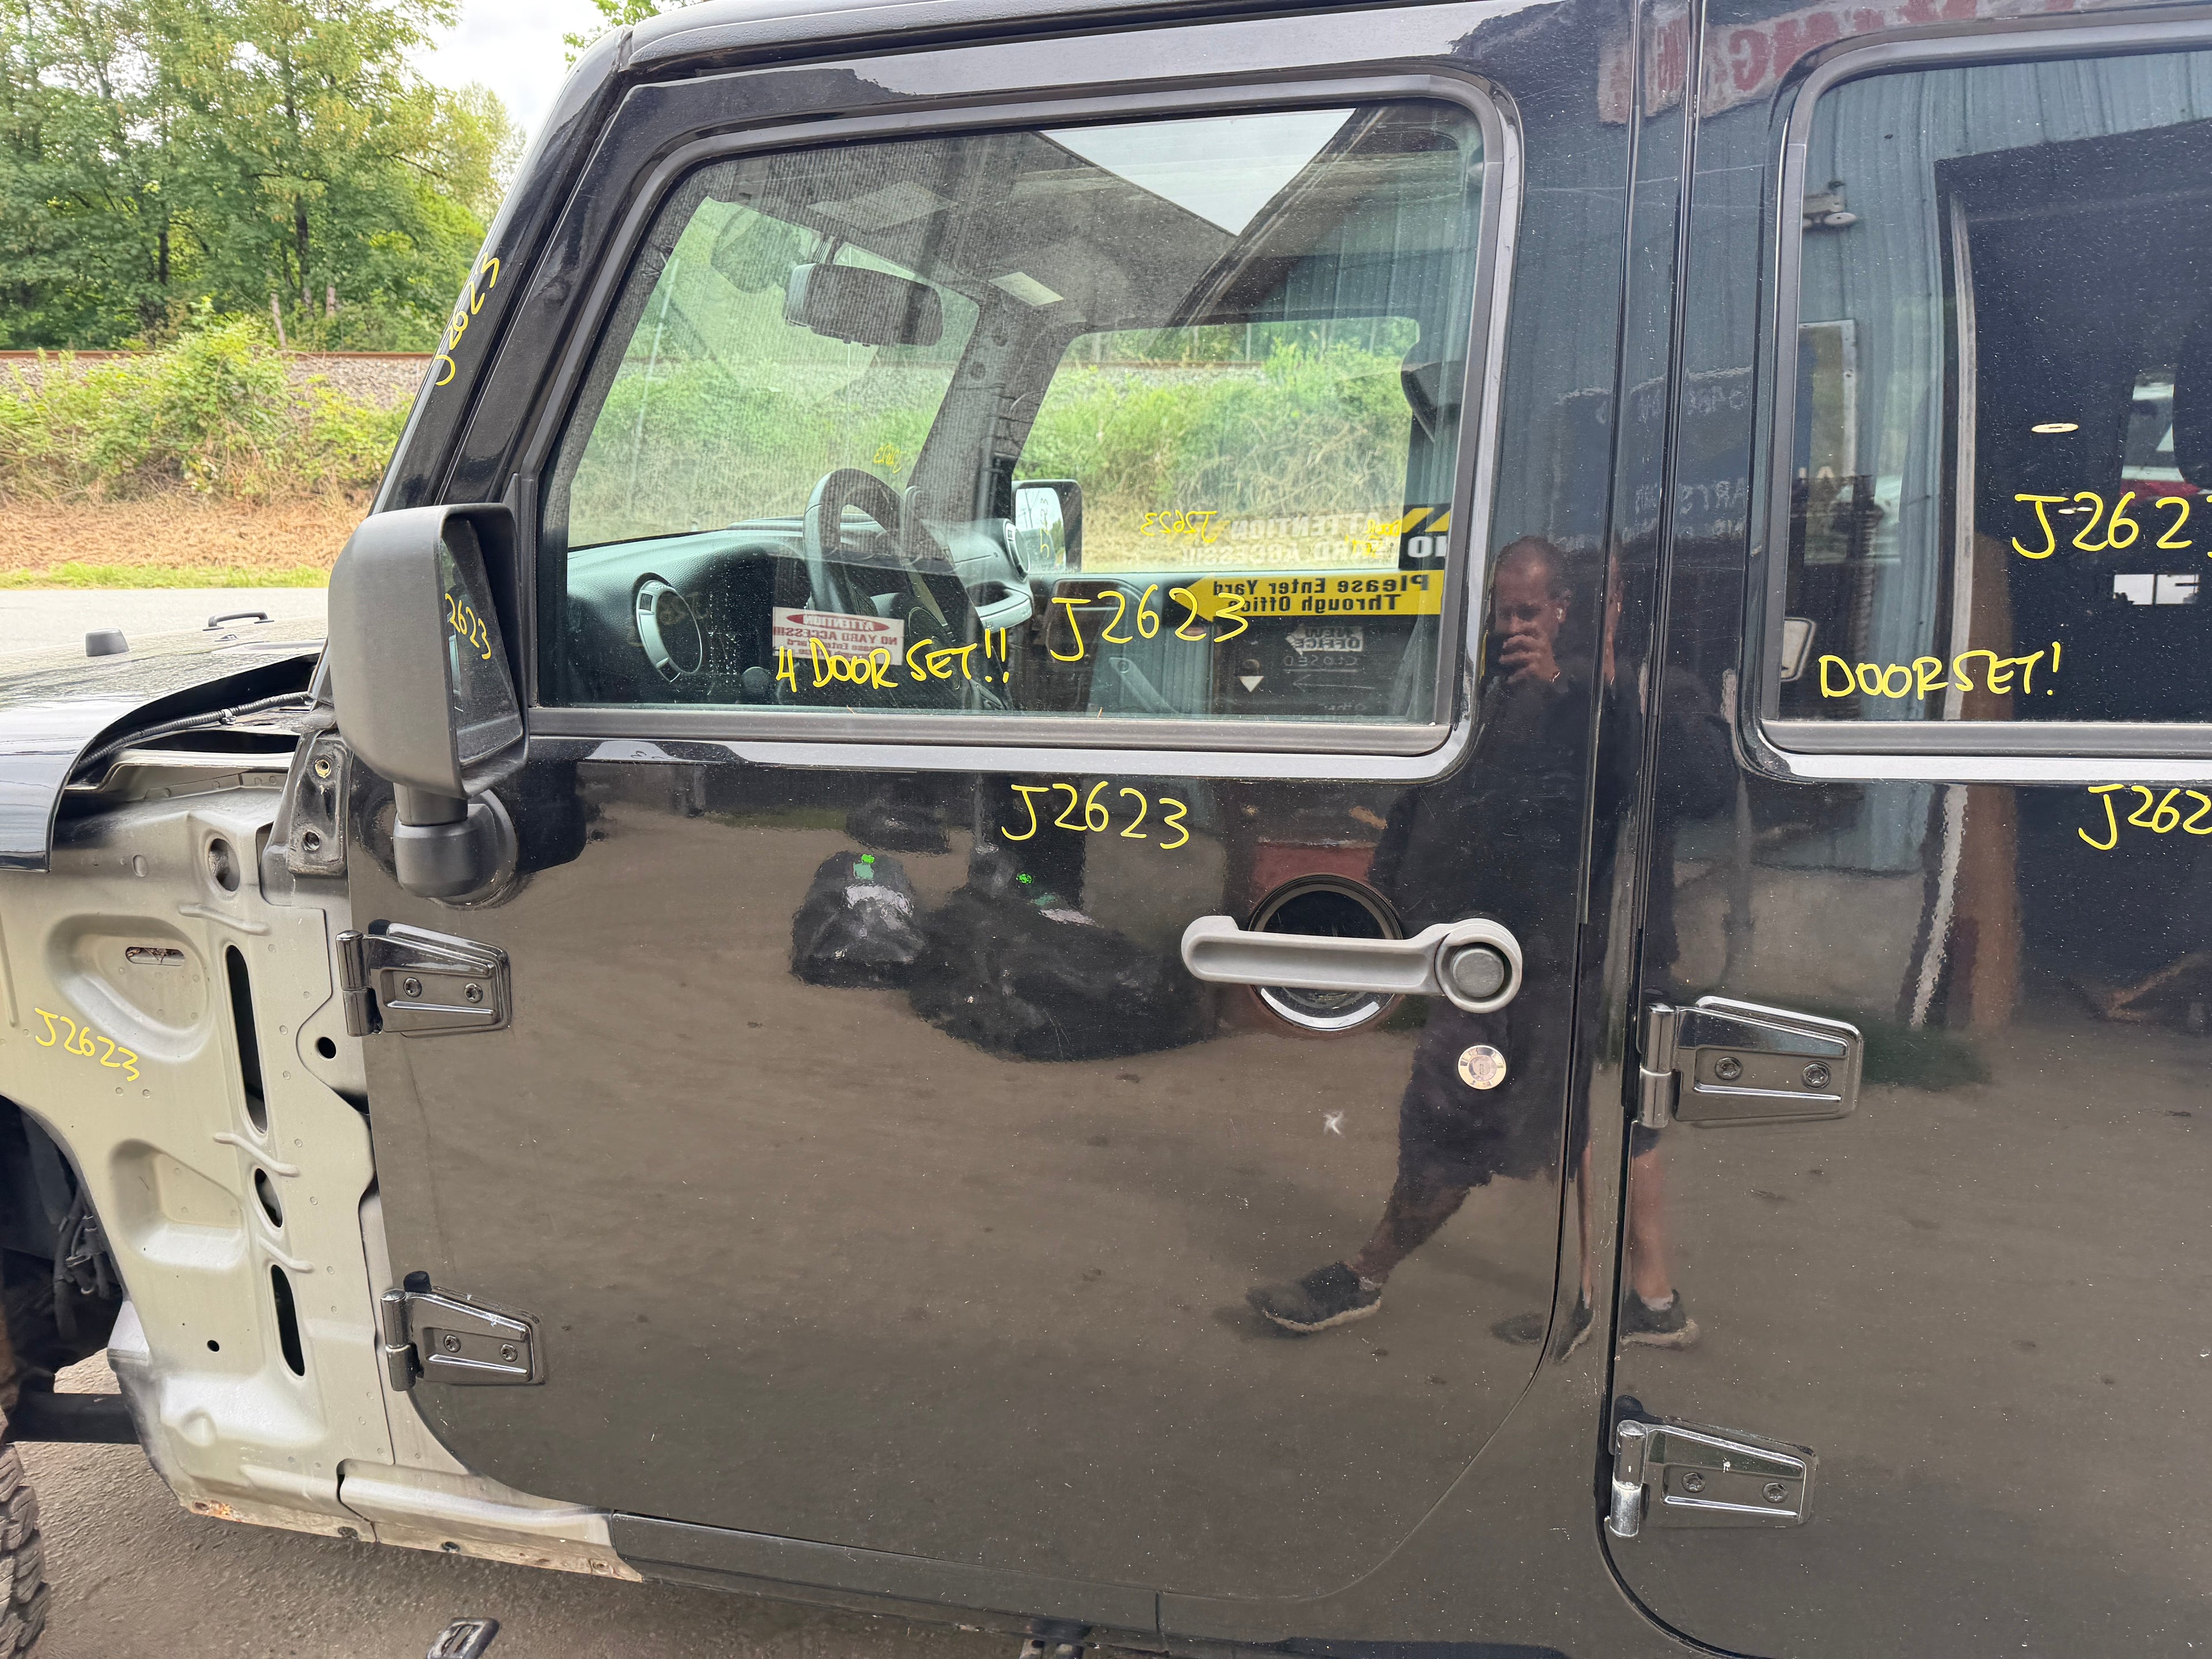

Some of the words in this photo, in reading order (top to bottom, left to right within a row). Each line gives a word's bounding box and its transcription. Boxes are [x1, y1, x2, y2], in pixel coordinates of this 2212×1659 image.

[2012, 491, 2212, 559] J262
[445, 593, 491, 660] 2623
[1050, 584, 1248, 661] J2623
[776, 646, 797, 692] 4
[809, 637, 899, 690] DOOR
[1001, 781, 1190, 850] J2623
[2078, 783, 2212, 850] J262
[34, 1007, 140, 1082] J2623
